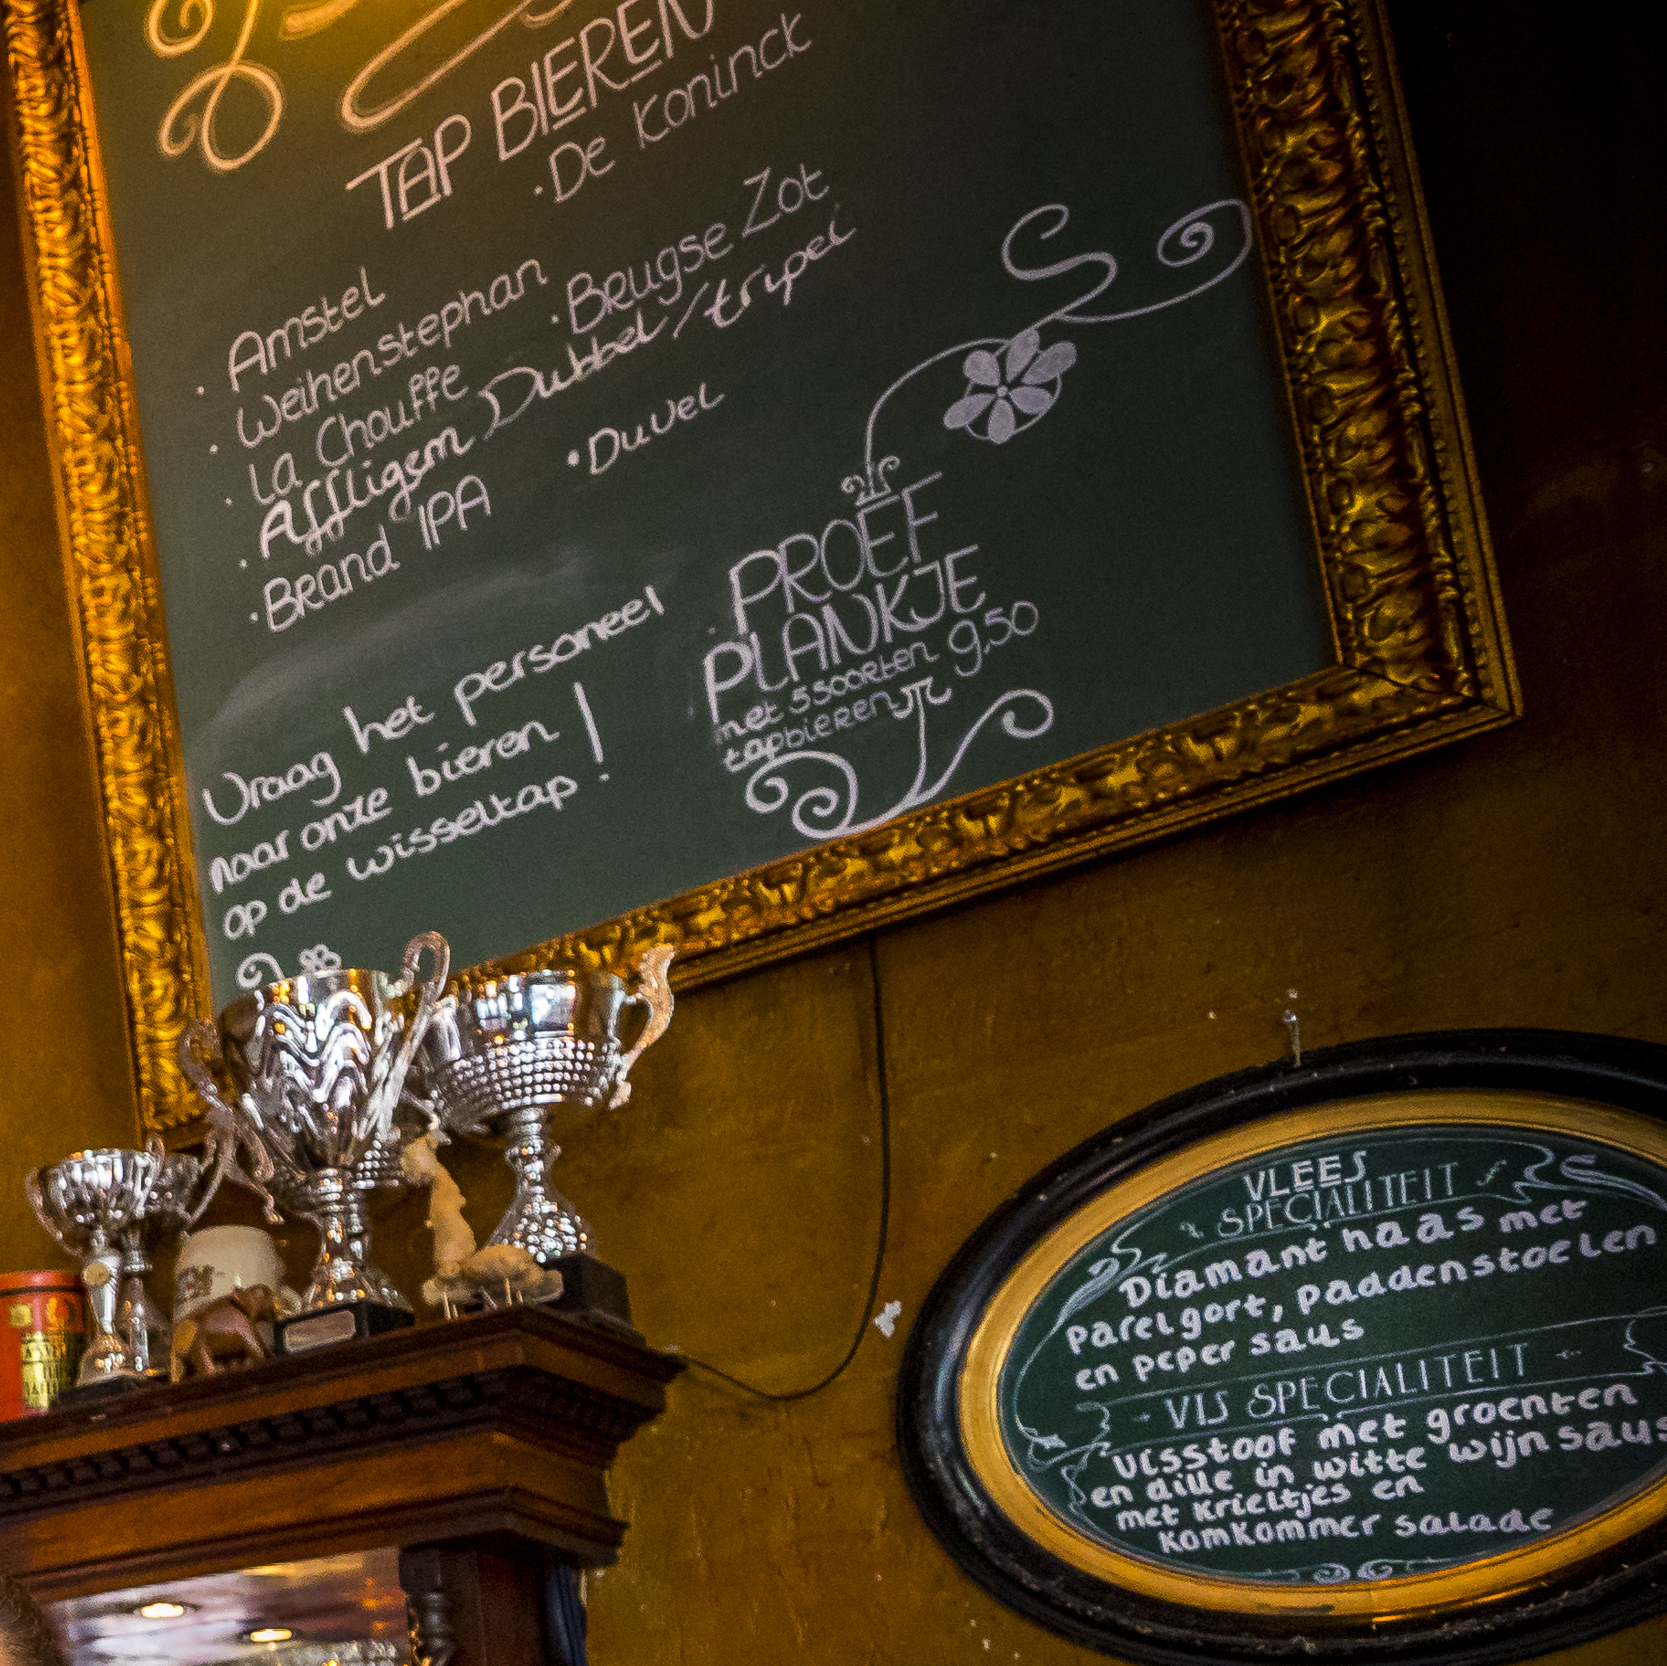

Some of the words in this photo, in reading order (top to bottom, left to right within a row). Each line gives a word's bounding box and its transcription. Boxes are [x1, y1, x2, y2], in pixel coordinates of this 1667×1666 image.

[347, 114, 472, 230] TAP
[492, 0, 715, 162] BIEREN
[549, 132, 616, 203] De
[634, 13, 812, 149] Koninck
[742, 163, 830, 239] Zot
[228, 266, 387, 393] Amstel
[237, 257, 549, 450] Weihenstephan
[315, 360, 470, 470] Chouffe
[587, 382, 726, 476] Duvel
[258, 428, 475, 559] Affligem
[263, 531, 400, 634] Brand
[419, 474, 494, 551] IPA
[728, 472, 943, 635] PROEF
[703, 545, 987, 724] PLANKJE
[202, 745, 342, 827] Vraag
[343, 694, 436, 753] het
[454, 585, 665, 727] personeel
[723, 689, 910, 772] tapbieren
[209, 826, 290, 893] naar
[300, 787, 393, 851] onze
[409, 717, 561, 794] bieren
[221, 900, 267, 941] op
[278, 864, 333, 918] de
[1217, 1160, 1460, 1238] SPECIALITEIT
[1243, 1150, 1367, 1201] VLEES
[1498, 1199, 1588, 1234] met
[1296, 1224, 1658, 1315] paddenstoelen
[1075, 1363, 1120, 1391] en
[1245, 1342, 1529, 1419] SPECIALITEIT
[1318, 1412, 1407, 1450] met
[1426, 1384, 1638, 1445] groenten
[1090, 1483, 1135, 1509] en
[1254, 1461, 1296, 1489] in
[1312, 1445, 1428, 1482] witte
[1115, 1503, 1180, 1532] met
[1371, 1475, 1425, 1501] en
[1394, 1507, 1555, 1538] salade
